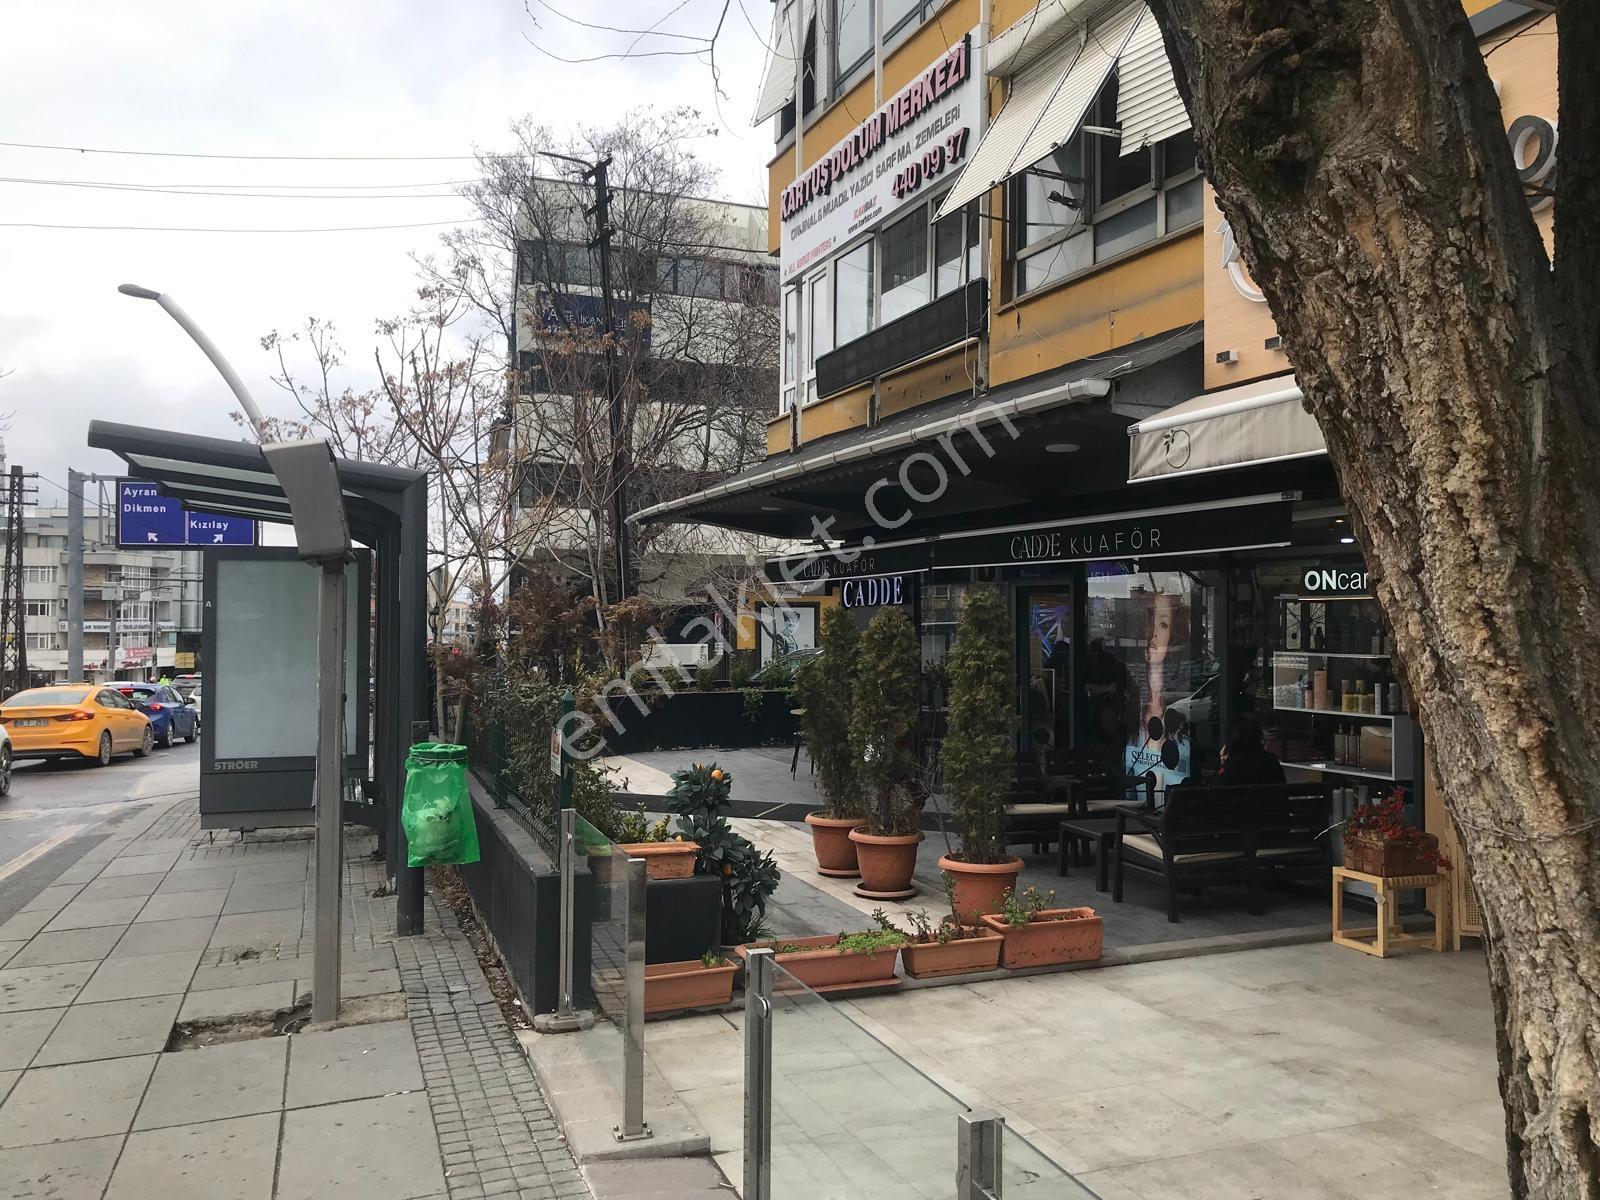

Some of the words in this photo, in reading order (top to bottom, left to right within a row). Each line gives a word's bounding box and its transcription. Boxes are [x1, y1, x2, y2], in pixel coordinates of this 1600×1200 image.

[781, 159, 832, 221] KARTUŞ
[831, 115, 886, 182] DOLUM
[886, 35, 970, 137] MERKEZİ
[876, 151, 897, 180] SARF
[891, 163, 921, 199] 440
[921, 145, 946, 180] 09
[945, 127, 970, 164] 37
[123, 487, 157, 497] Ayran
[124, 504, 166, 513] Dikmen
[190, 520, 229, 531] Kızılay
[1010, 533, 1061, 560] CADDE
[1070, 527, 1161, 555] KUAFÖR
[843, 575, 903, 608] CADDE
[213, 760, 258, 770] STRÖER
